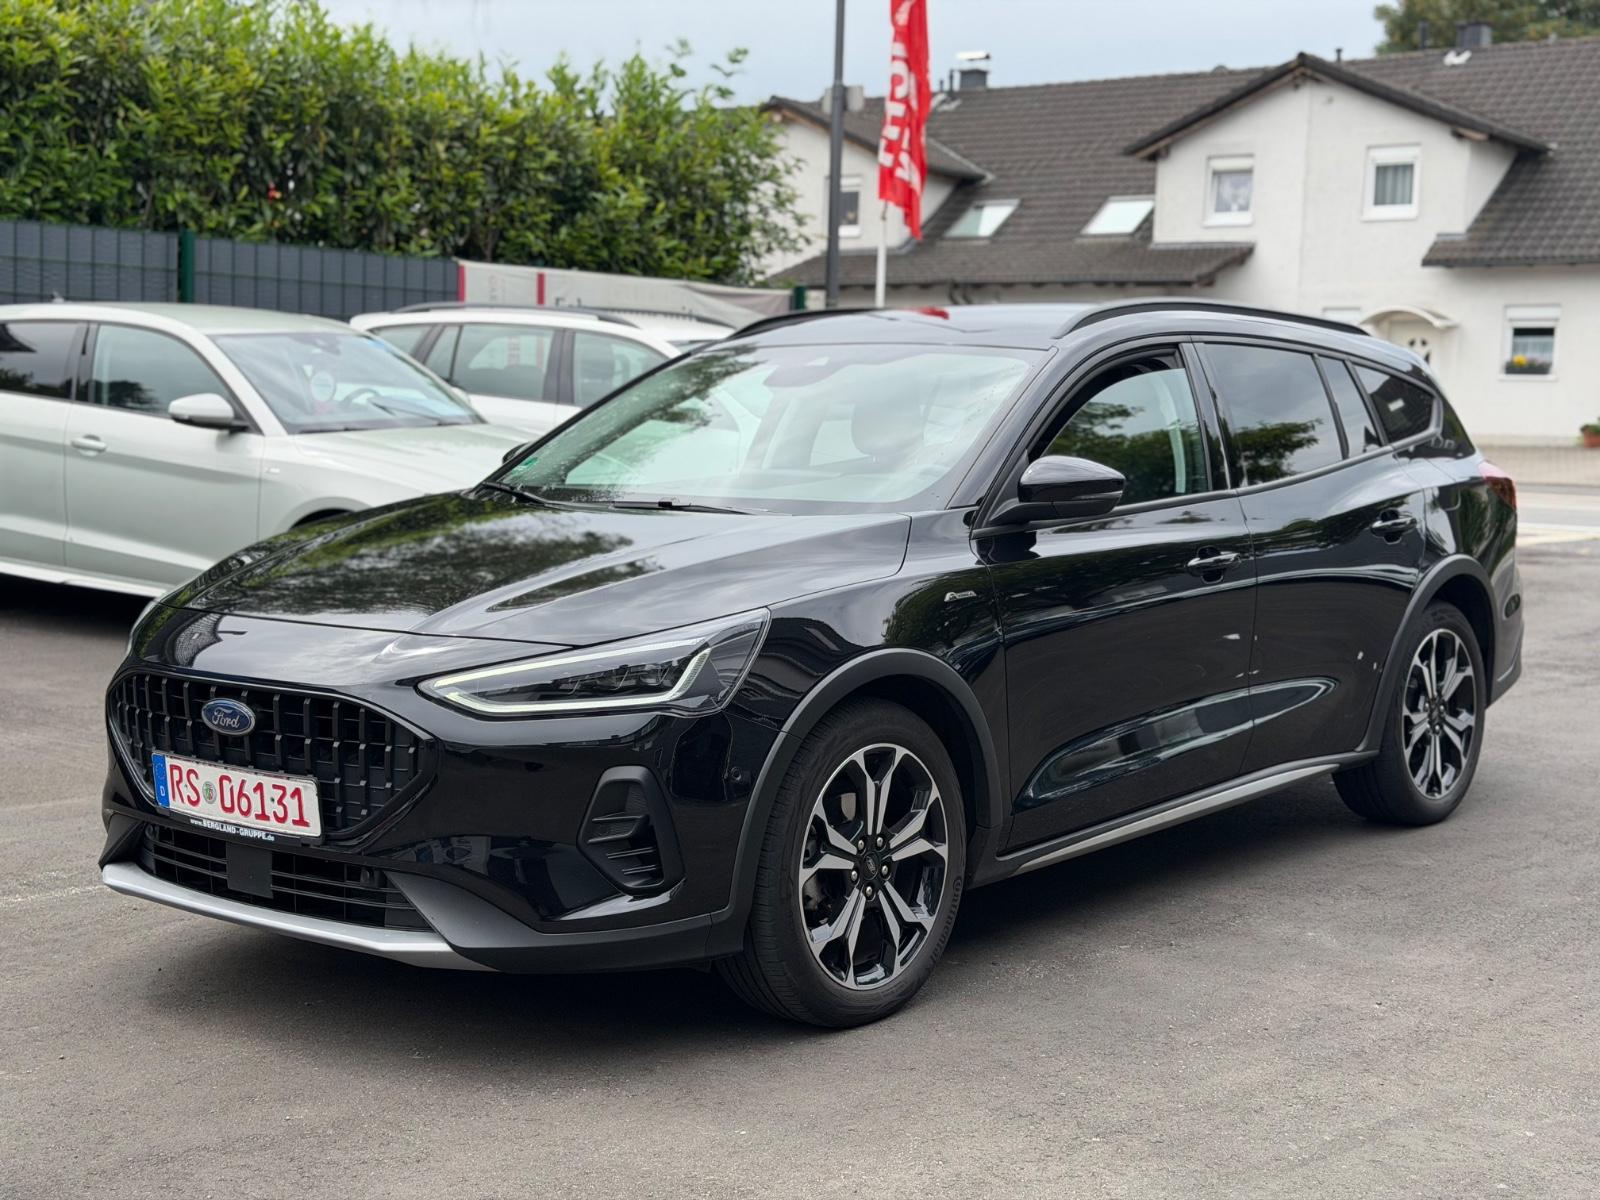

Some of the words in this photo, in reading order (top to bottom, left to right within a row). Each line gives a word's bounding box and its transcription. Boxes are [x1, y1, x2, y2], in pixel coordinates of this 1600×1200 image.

[212, 707, 240, 729] Ford
[169, 764, 201, 807] RS
[219, 775, 310, 827] 06131
